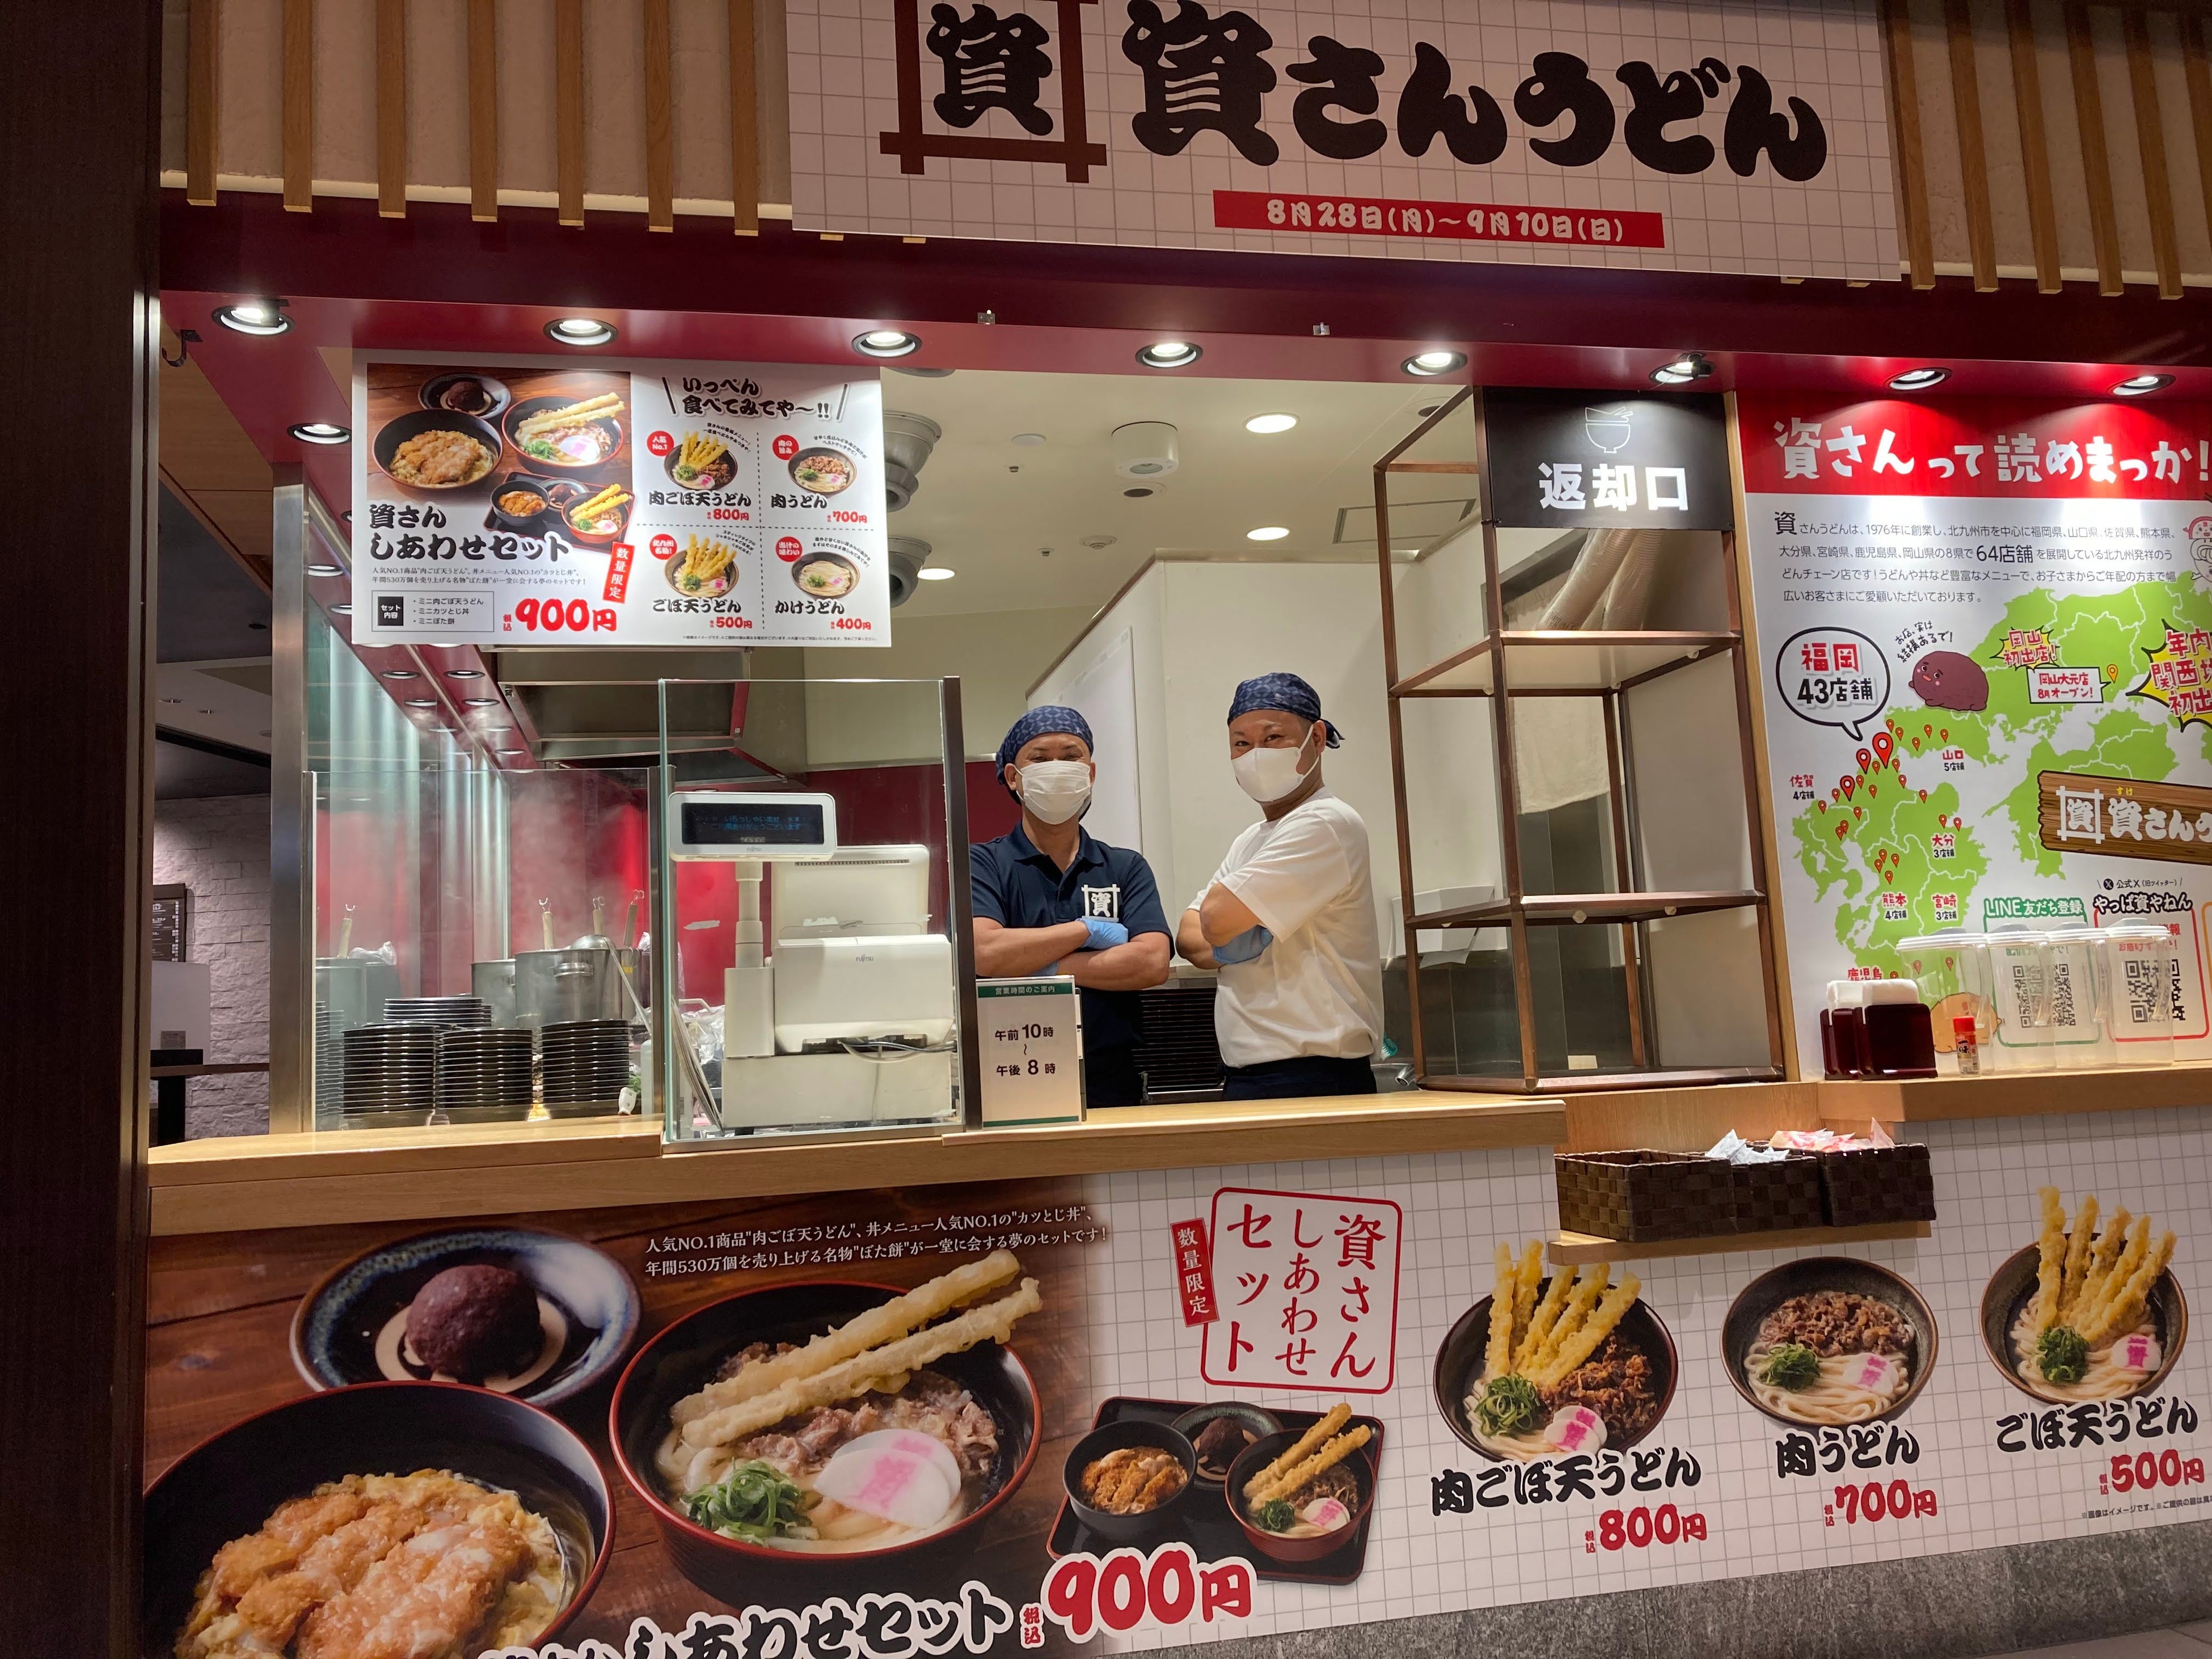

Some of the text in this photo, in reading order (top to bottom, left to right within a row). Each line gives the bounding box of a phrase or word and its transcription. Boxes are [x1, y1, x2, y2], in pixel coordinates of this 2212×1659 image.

[1121, 0, 1827, 182] 資さんうどん
[682, 378, 759, 396] いっぺん
[1538, 462, 1688, 511] 返却口
[649, 491, 752, 506] 肉ごぼ天うどん
[771, 493, 828, 509] 肉うどん
[369, 504, 446, 529] 資さん
[713, 508, 749, 521] 800円
[833, 511, 868, 523] 700円
[370, 532, 569, 561] しあわせセット
[609, 547, 628, 599] 数量限定
[1783, 590, 1982, 603] 広いお客さまにご愛顧いただいております。
[652, 598, 742, 613] ごぼ天うどん
[775, 600, 845, 614] かけうどん
[515, 598, 617, 632] 900円
[716, 617, 753, 628] 500円
[836, 618, 871, 630] 400円
[2008, 630, 2042, 648] 岡山
[2167, 628, 2211, 657] 年内
[1801, 642, 1859, 673] 福岡
[2038, 673, 2089, 685] 岡山大元店
[1797, 677, 1873, 704] 43店舗
[1942, 749, 1964, 760] 山口
[1944, 762, 1965, 771] 5店舗
[1789, 774, 1814, 788] 佐賀
[1793, 790, 1815, 800] 4店舗
[1932, 834, 1955, 847] 大分
[1934, 849, 1955, 858] 3店舗
[1882, 893, 1907, 907] 熊本
[1932, 894, 1957, 908] 宮崎
[2094, 893, 2192, 913] やっぱ資やねん
[1885, 910, 1907, 920] 4店舗
[1936, 910, 1957, 920] 3店舗
[855, 953, 874, 963] FUJITSU
[995, 985, 1056, 995] 営業時間のご案内
[994, 1024, 1054, 1041] 午前10時
[1177, 1226, 1210, 1316] 数量限定
[1226, 1204, 1272, 1373] セット
[1275, 1208, 1324, 1376] しあわせ
[1329, 1214, 1386, 1378] 資さん
[1996, 1396, 2198, 1453] ごぼ天うどん
[1775, 1424, 1920, 1479] 肉うどん
[2110, 1448, 2205, 1493] 500円
[1430, 1446, 1702, 1517] 肉ごぼ天うどん
[1834, 1479, 1938, 1525] 700円
[1598, 1502, 1708, 1551] 800円
[1024, 1606, 1042, 1644] 税込
[1048, 1549, 1252, 1635] 900円
